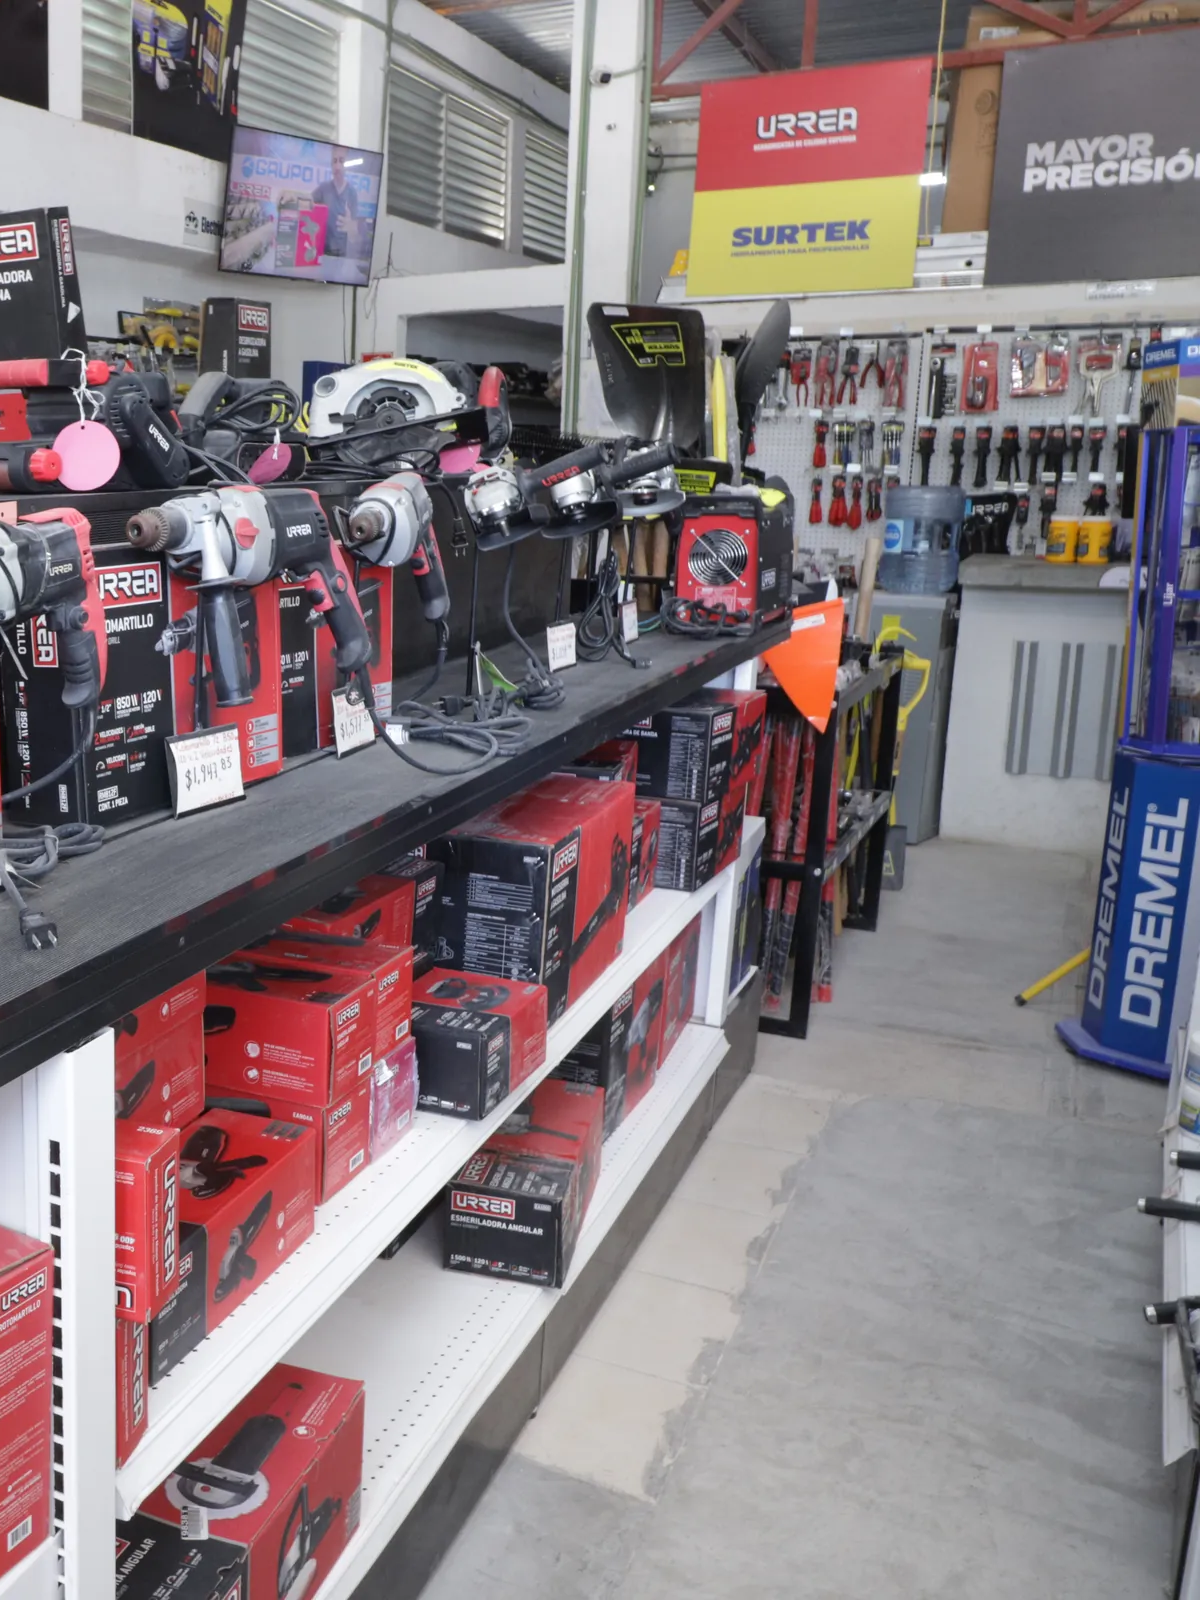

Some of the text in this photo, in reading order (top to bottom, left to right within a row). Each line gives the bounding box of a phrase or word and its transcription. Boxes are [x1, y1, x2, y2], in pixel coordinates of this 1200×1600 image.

[757, 107, 857, 139] URREA
[1026, 132, 1154, 167] MAYOR
[732, 219, 871, 248] SURTEK
[148, 424, 171, 452] URREA
[542, 465, 581, 487] URREA
[287, 524, 312, 538] URREA
[50, 563, 73, 576] URREA
[100, 569, 158, 599] RREA
[105, 613, 154, 633] OMARTILLO
[116, 697, 131, 710] 850
[143, 690, 156, 704] 120
[554, 842, 578, 873] URREA
[1089, 787, 1129, 1010] DREMEL
[1119, 797, 1189, 1029] DREMEL
[378, 970, 399, 991] URREA
[337, 1003, 360, 1026] URREA
[329, 1102, 351, 1125] URREA
[456, 1194, 512, 1215] URREA
[164, 1159, 176, 1283] URREA
[451, 1214, 506, 1229] ESMERILADORA
[508, 1224, 543, 1235] ANGULAR
[2, 1272, 45, 1312] URREA
[120, 1538, 156, 1575] ANGULAR
